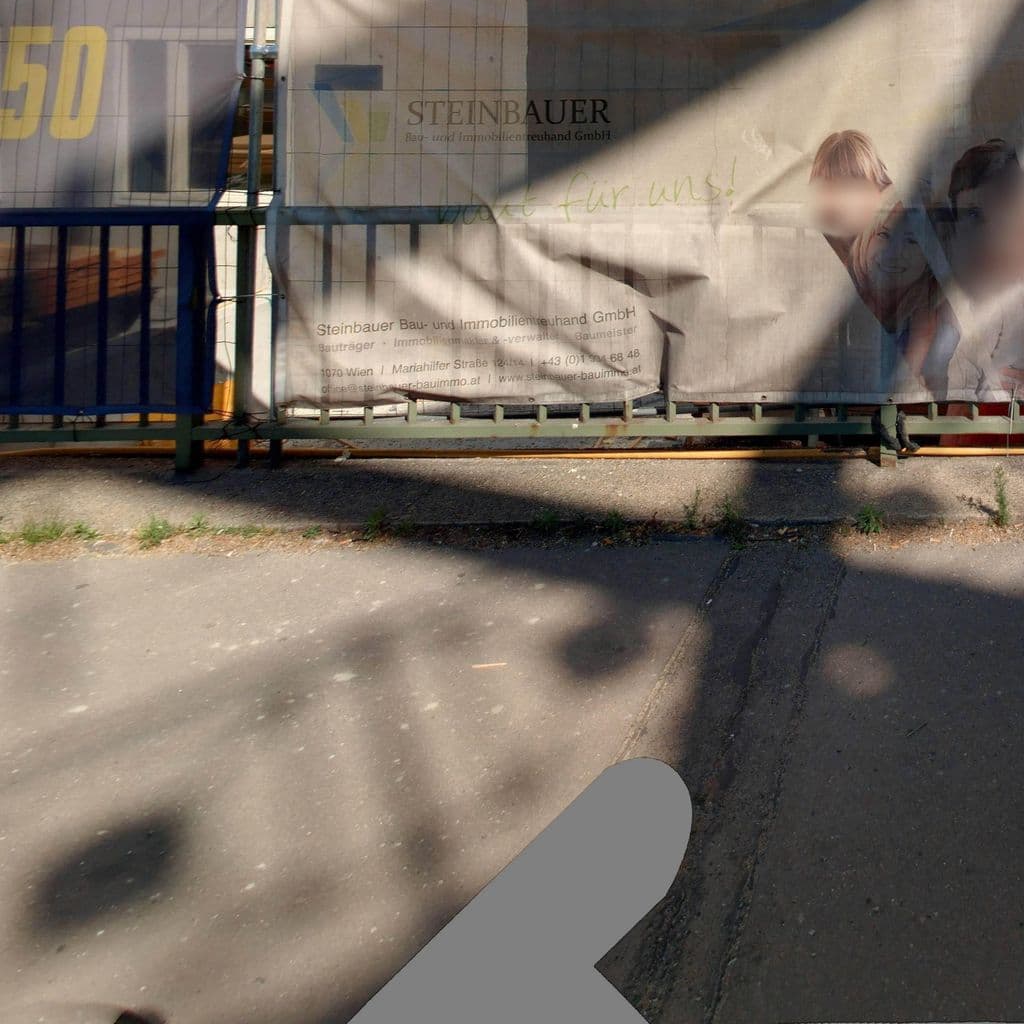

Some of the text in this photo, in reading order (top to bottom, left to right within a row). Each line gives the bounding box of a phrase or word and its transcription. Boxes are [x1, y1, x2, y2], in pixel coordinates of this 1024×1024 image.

[0, 25, 108, 140] 50
[406, 98, 612, 126] STEINBAUER
[404, 131, 428, 143] Bau-
[432, 131, 456, 143] und
[574, 129, 612, 142] GmbH
[560, 172, 629, 223] für
[316, 306, 636, 336] Steinbauer Bau- und Immobilientreuhand GmbH
[575, 325, 638, 341] Baumeister
[321, 368, 343, 378] 1070
[345, 367, 374, 377] Wien
[391, 361, 450, 375] Mariahilfer
[453, 358, 488, 370] Straße
[610, 352, 624, 363] 68
[627, 348, 641, 360] 48
